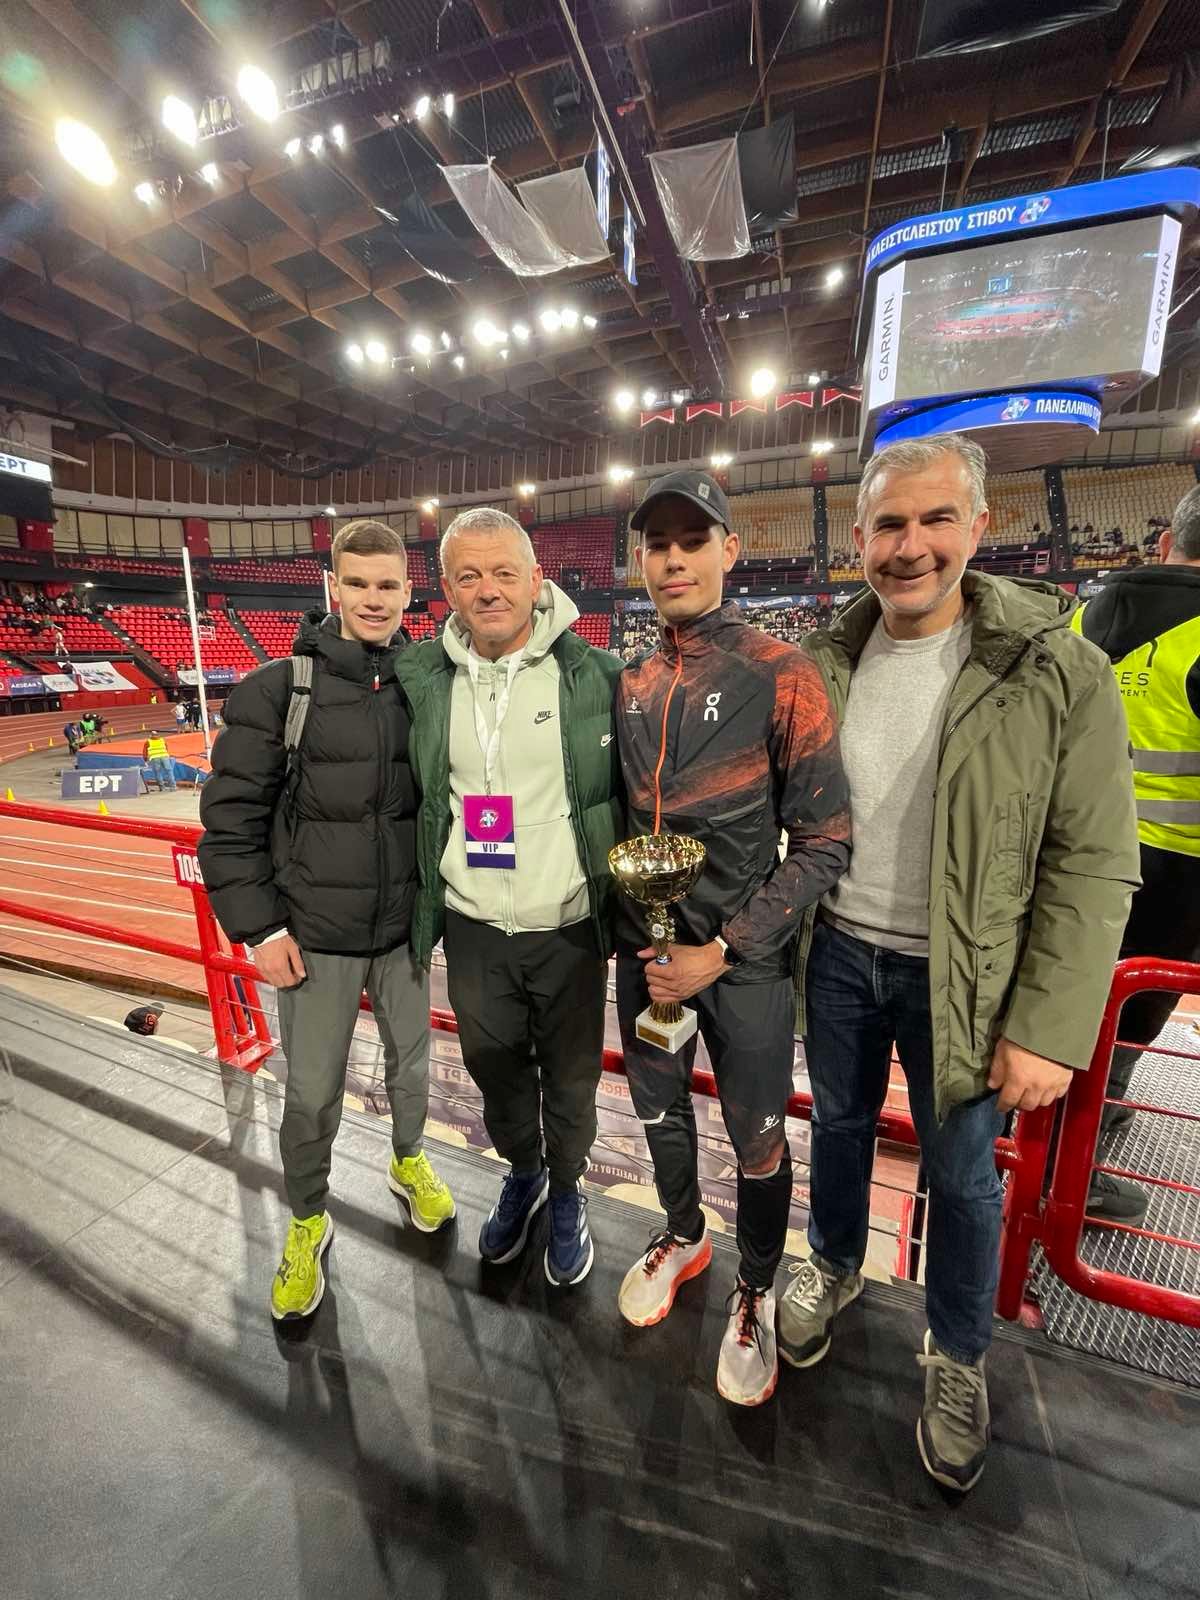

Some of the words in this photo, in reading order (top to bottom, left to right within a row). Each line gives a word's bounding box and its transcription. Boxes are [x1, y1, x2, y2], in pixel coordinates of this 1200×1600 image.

[967, 206, 1017, 230] ΣΤΙΒΟΥ
[1151, 253, 1172, 345] GARMIN
[878, 294, 895, 381] GARMIN
[1114, 671, 1150, 686] ES
[537, 710, 552, 718] NIKE
[79, 775, 122, 792] ΕΡΤ
[483, 843, 499, 853] VIP
